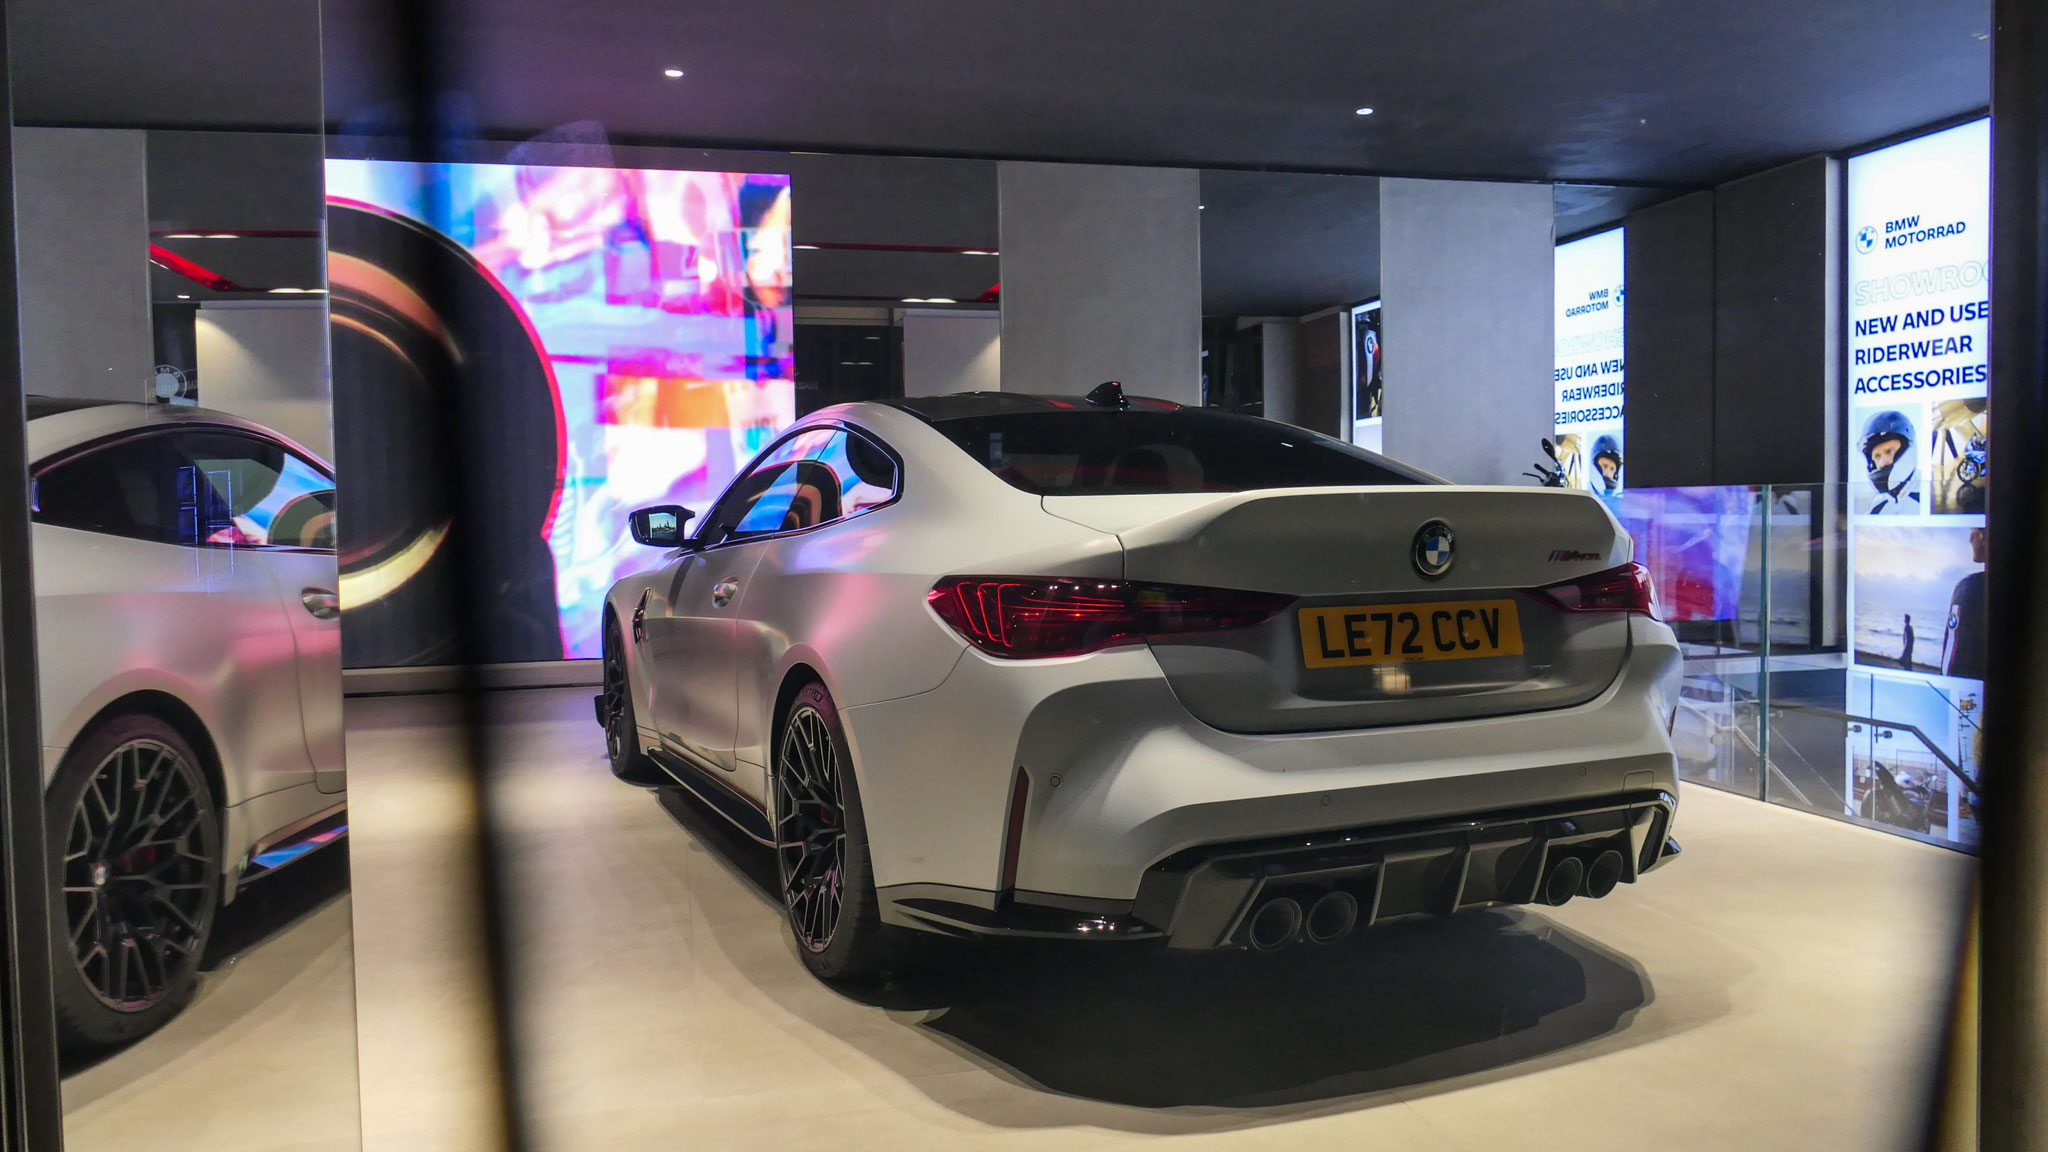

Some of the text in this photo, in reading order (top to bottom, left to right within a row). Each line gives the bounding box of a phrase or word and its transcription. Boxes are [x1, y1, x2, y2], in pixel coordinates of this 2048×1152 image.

[1885, 215, 1920, 233] BMW
[1885, 221, 1966, 249] MOTORRAD
[1855, 260, 1988, 306] SHOWRO
[1855, 300, 1989, 337] NEW AND USE
[1855, 335, 1973, 366] RIDERWEAR
[1854, 364, 1987, 395] ACCESSORIES
[1316, 608, 1500, 659] LE72 CCV
